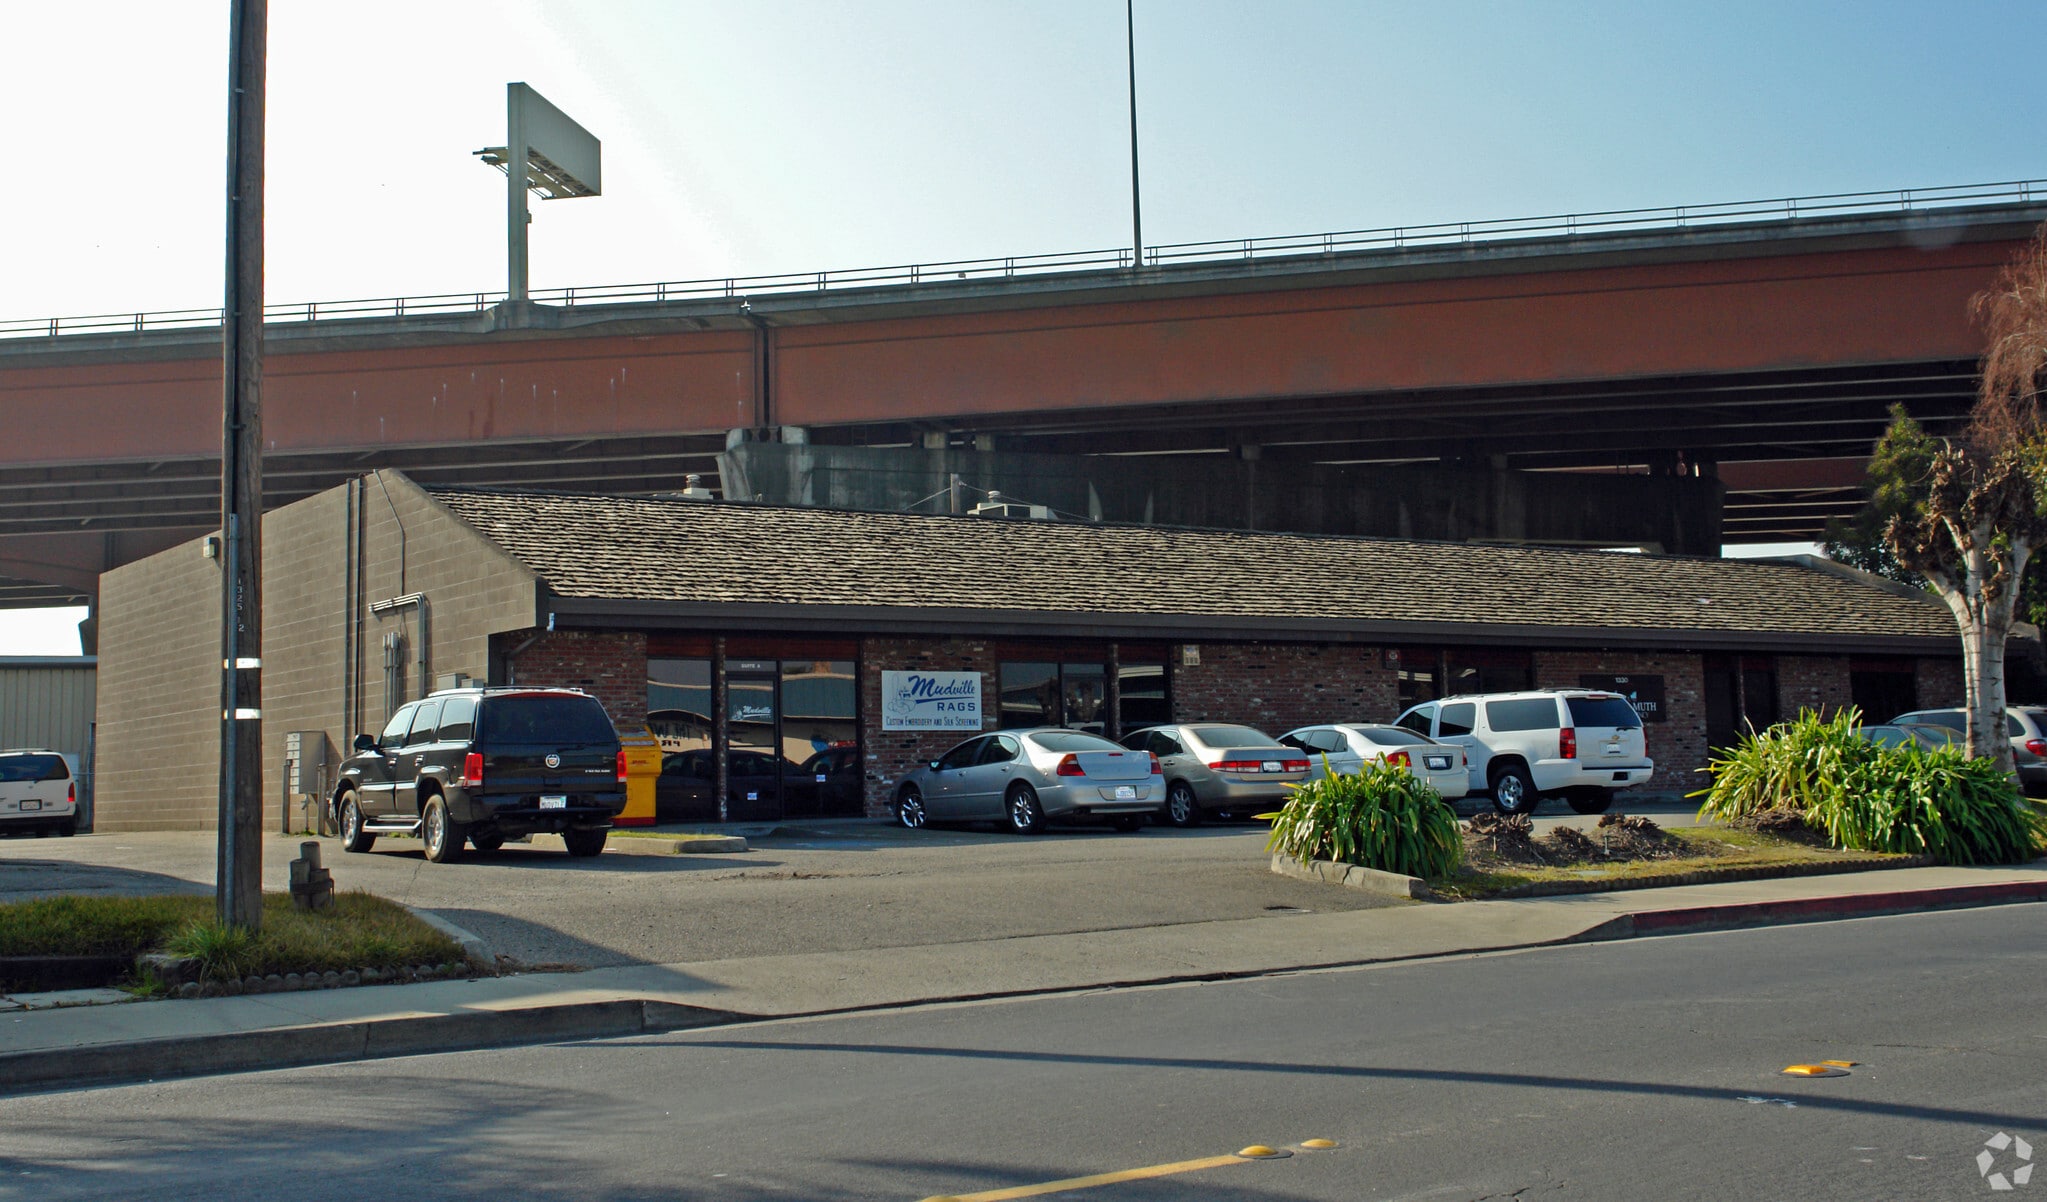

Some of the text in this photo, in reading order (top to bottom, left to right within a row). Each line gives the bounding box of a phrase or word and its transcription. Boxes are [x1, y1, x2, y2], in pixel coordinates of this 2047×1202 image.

[908, 675, 975, 697] Mudville
[937, 702, 975, 711] RAGS
[905, 716, 932, 726] EMBROIDERY
[955, 716, 979, 726] SCREENING
